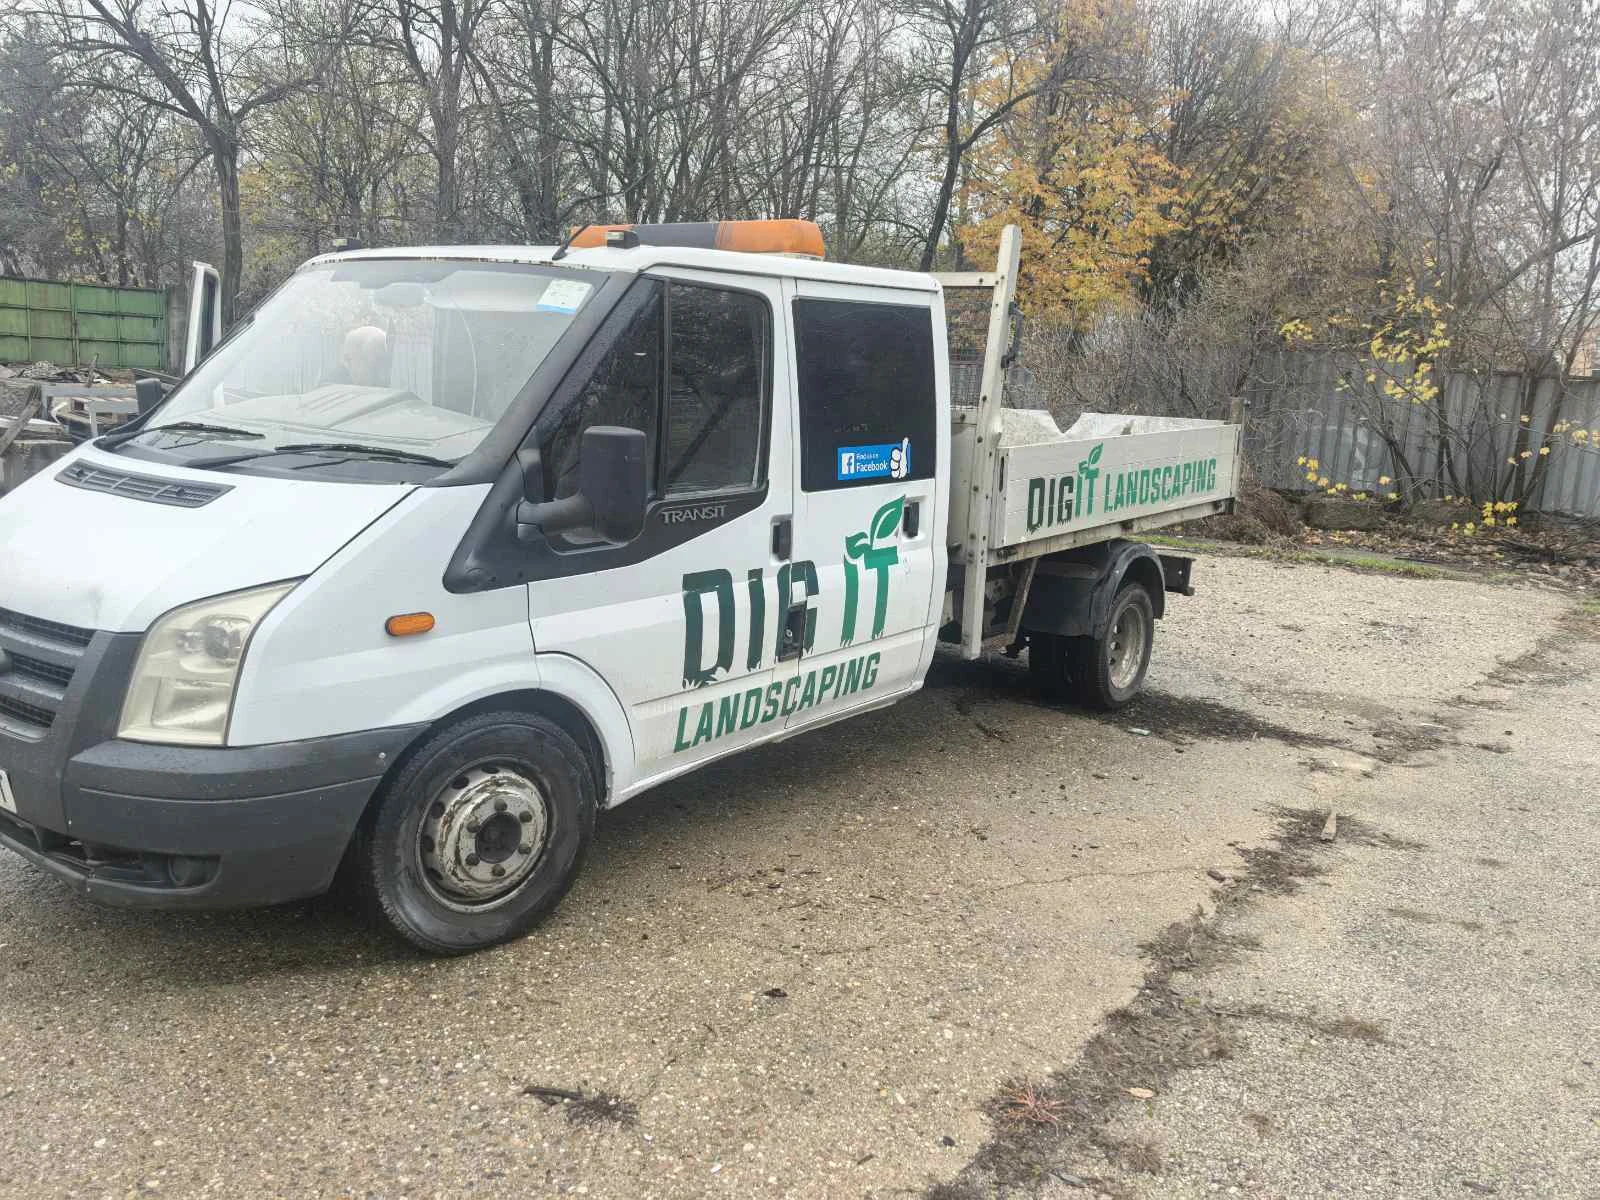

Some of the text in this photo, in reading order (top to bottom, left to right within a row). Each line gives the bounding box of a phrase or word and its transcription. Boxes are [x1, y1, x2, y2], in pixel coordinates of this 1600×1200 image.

[856, 460, 888, 473] Facebook
[1104, 458, 1216, 513] LANDSCAPING
[662, 505, 727, 524] TRANSIT
[673, 652, 881, 754] LANDSCAPING
